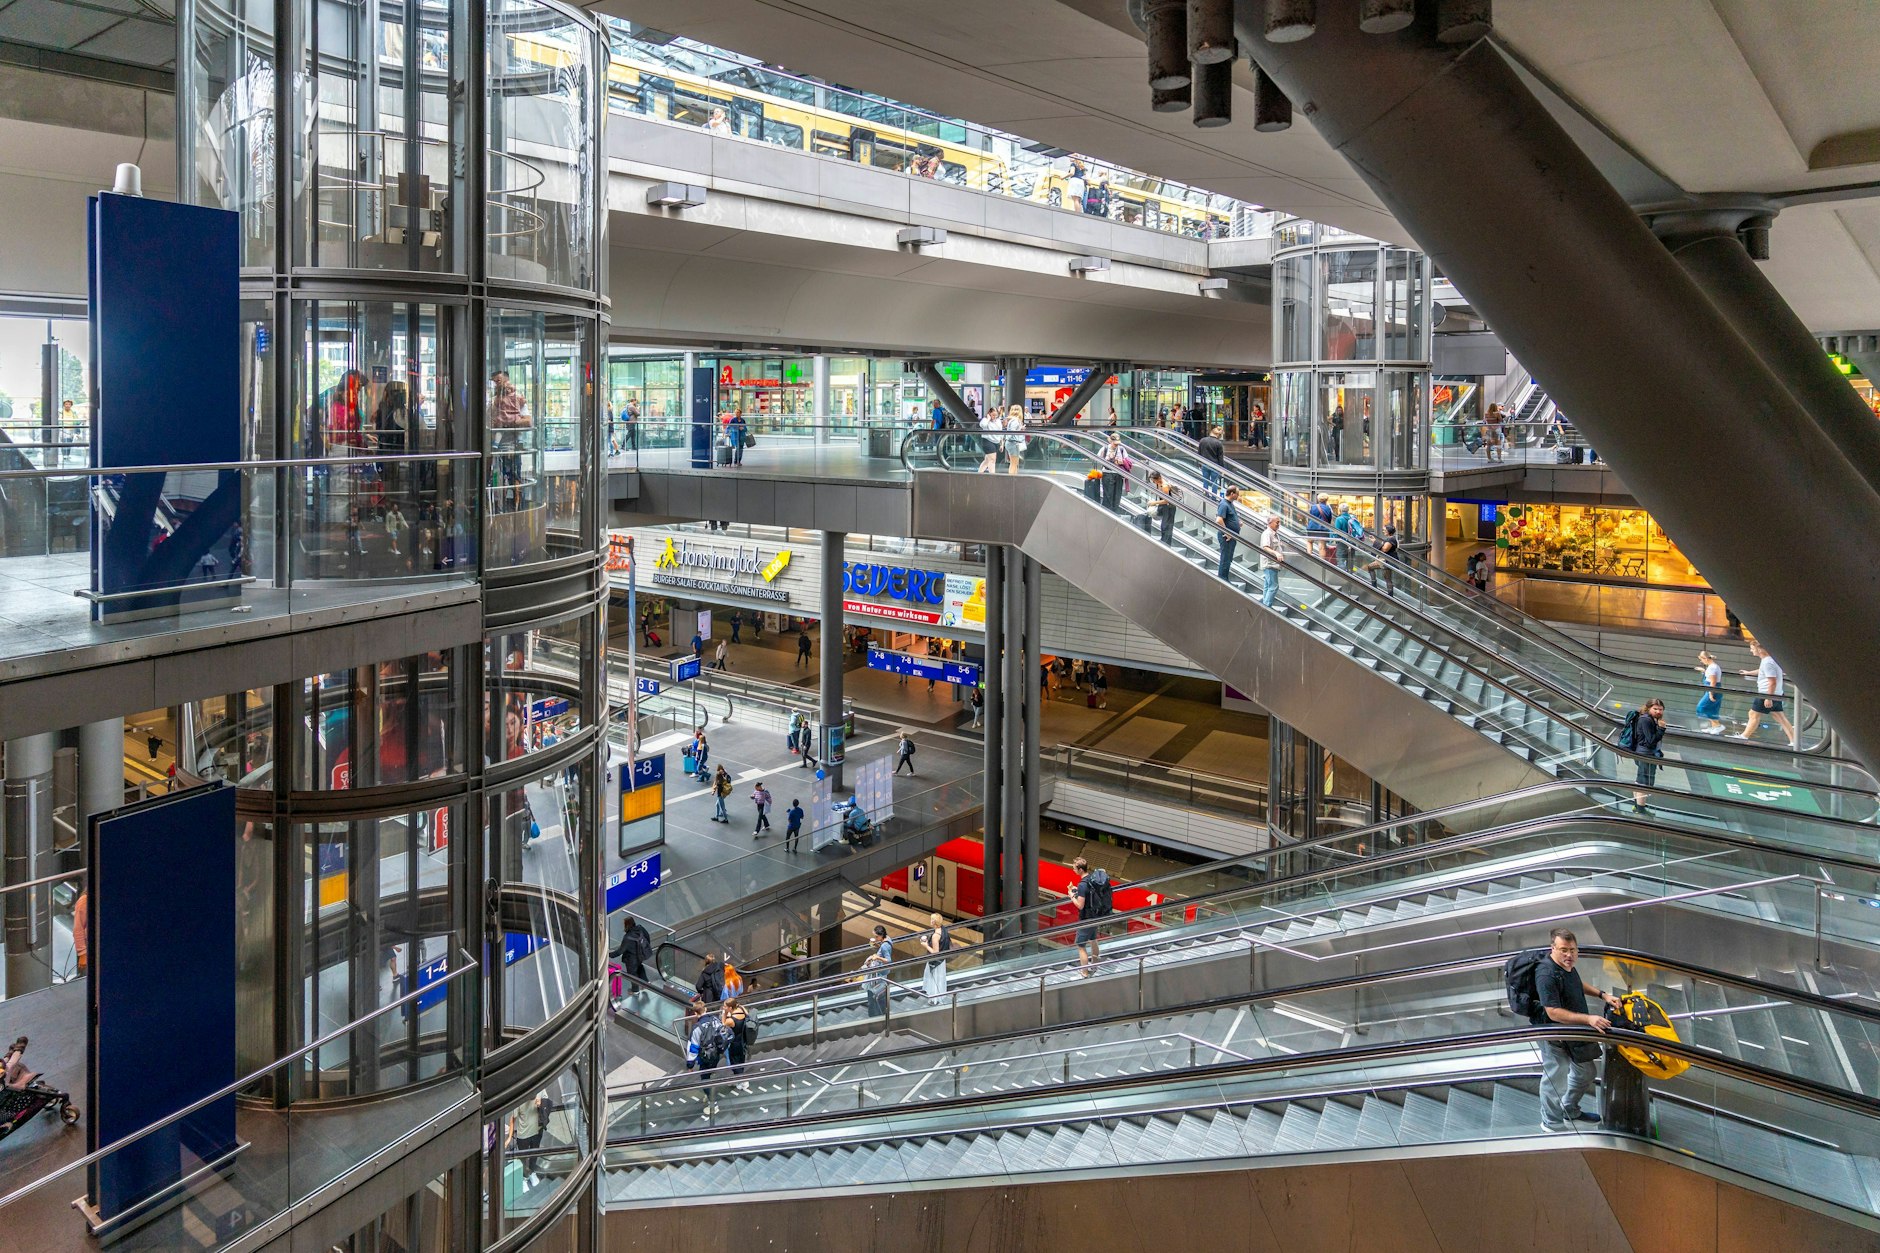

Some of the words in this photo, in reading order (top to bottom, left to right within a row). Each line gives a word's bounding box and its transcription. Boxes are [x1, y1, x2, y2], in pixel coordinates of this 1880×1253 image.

[681, 539, 707, 568] hans
[710, 551, 727, 569] im
[728, 544, 761, 579] glück
[654, 574, 676, 586] BURGER
[676, 577, 697, 589] SALATE
[698, 580, 729, 593] COCKTAILS
[730, 585, 787, 601] SONNENTERRASSE
[847, 603, 860, 611] von
[861, 605, 882, 614] Natur
[883, 609, 896, 617] aus
[897, 611, 929, 622] wirksam
[874, 651, 885, 660] 7-8
[901, 656, 912, 664] 7-8
[958, 666, 970, 674] 5-6
[638, 679, 644, 689] 5
[648, 681, 654, 691] 6
[630, 861, 648, 878] 5-8
[918, 865, 925, 877] D
[425, 959, 448, 980] 1-4
